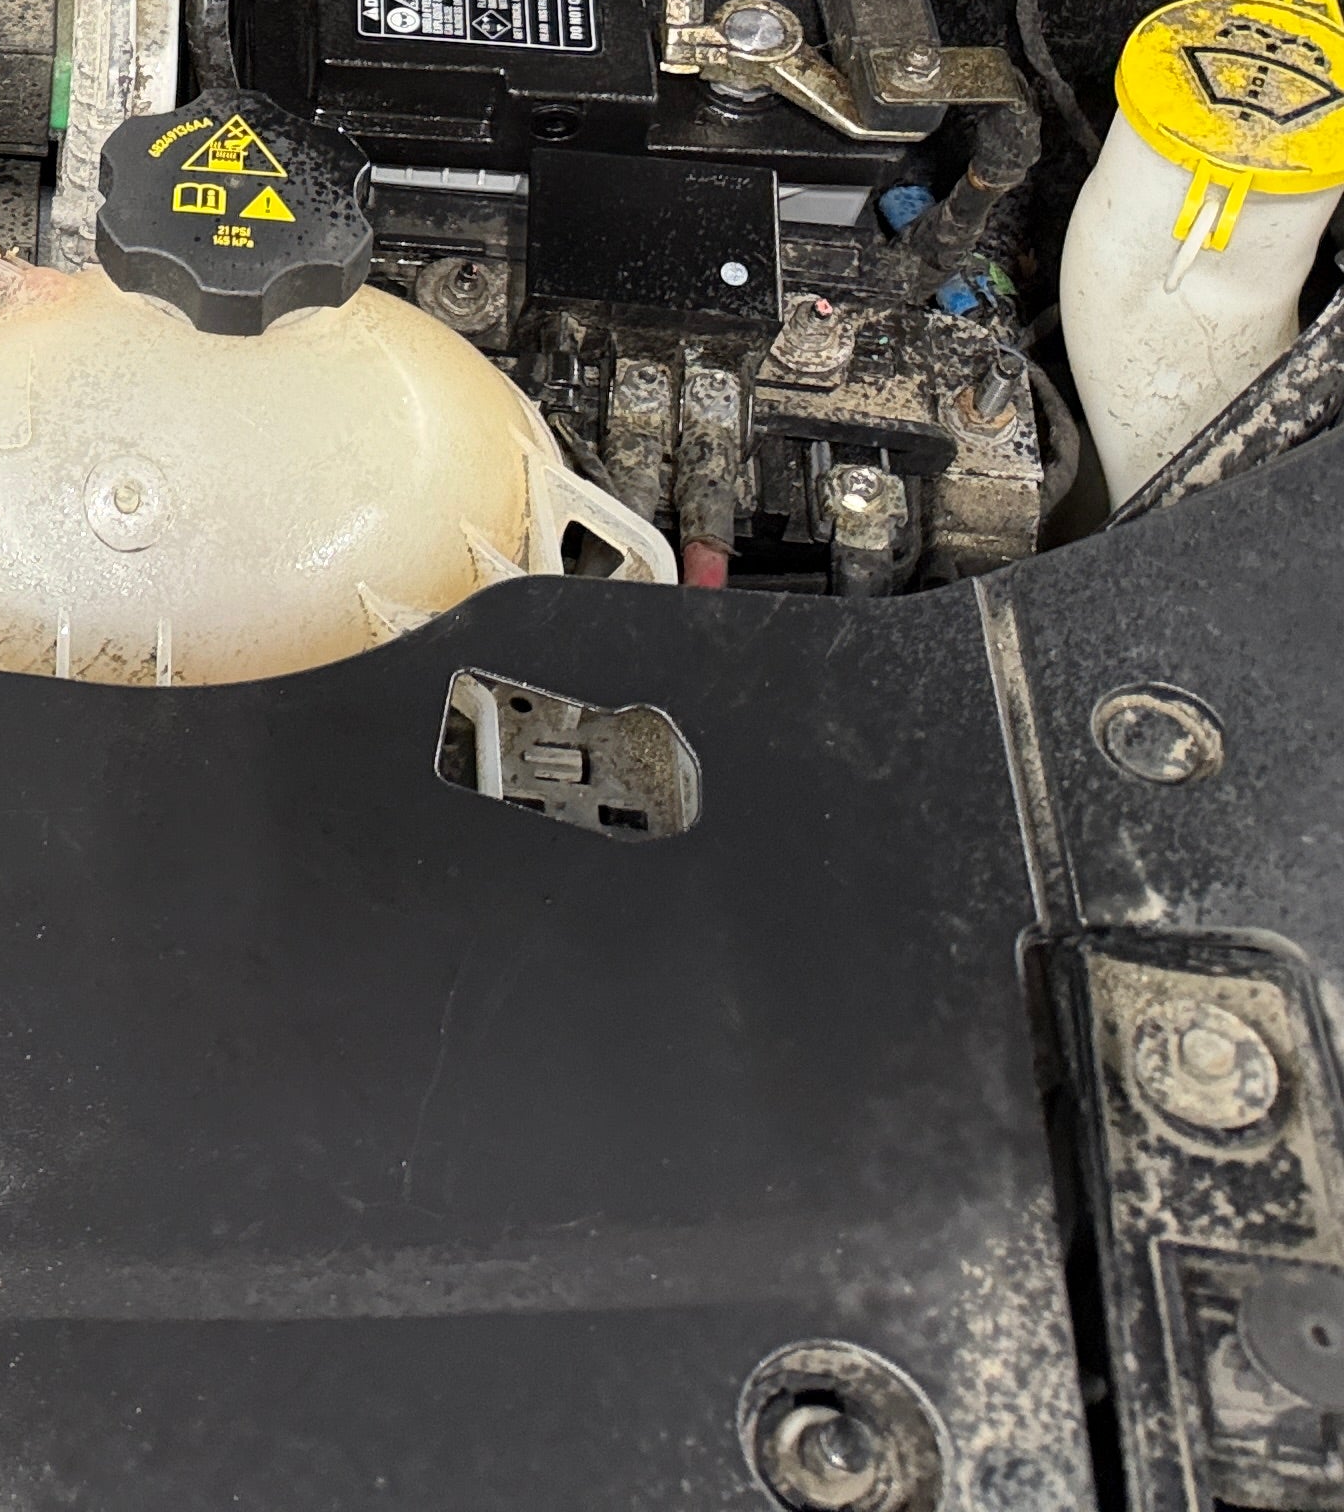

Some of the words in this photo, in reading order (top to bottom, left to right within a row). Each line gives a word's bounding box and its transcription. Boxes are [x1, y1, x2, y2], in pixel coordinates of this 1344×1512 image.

[569, 6, 582, 25] NOT
[570, 27, 582, 39] DO
[218, 226, 229, 235] 21
[231, 226, 251, 237] PSI
[213, 235, 230, 246] 145
[232, 237, 254, 248] kPa
